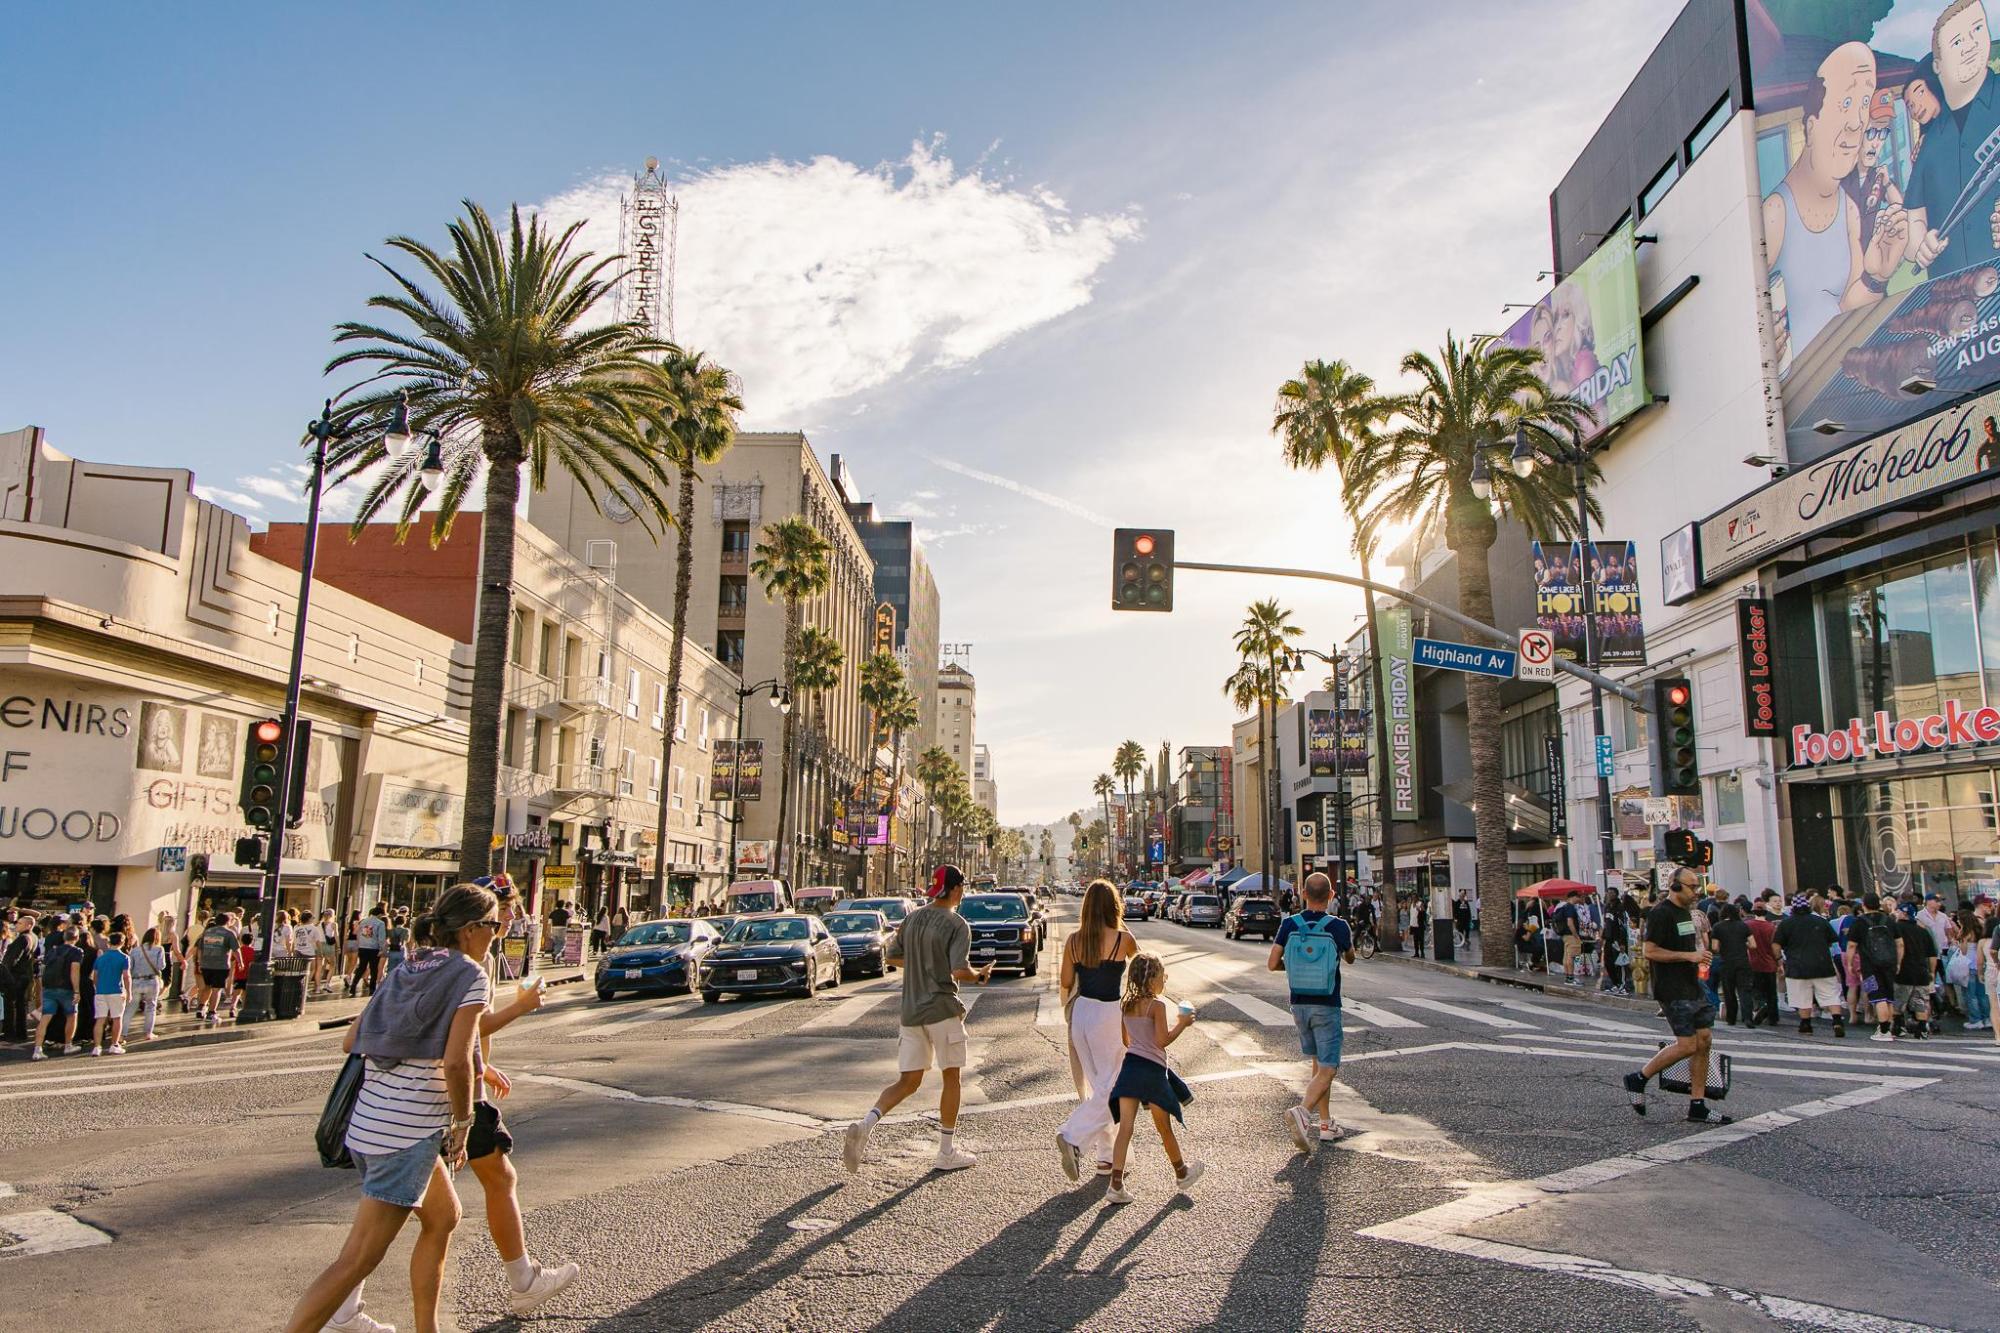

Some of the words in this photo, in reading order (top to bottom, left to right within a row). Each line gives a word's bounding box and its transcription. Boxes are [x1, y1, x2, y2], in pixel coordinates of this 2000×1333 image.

[638, 200, 656, 211] EL
[1926, 335, 1957, 359] NEW
[1961, 315, 2000, 342] SEAS
[1799, 405, 1976, 520] Michelob
[1537, 585, 1558, 594] SOME
[1595, 584, 1614, 593] SOME
[1537, 593, 1582, 614] HOT
[1595, 592, 1639, 613] HOT
[878, 613, 892, 625] EL
[1400, 619, 1408, 650] AUGUST
[1747, 605, 1768, 676] Locker
[1422, 645, 1482, 666] Highland
[1488, 655, 1505, 669] Av
[1522, 666, 1533, 675] ON
[1535, 667, 1550, 676] RED
[1339, 677, 1348, 692] PLAY
[1390, 655, 1410, 720] FRIDAY
[0, 696, 132, 738] ENIRS
[1752, 683, 1773, 729] Foot
[1310, 737, 1335, 749] HOT
[1341, 737, 1365, 749] HOT
[1792, 718, 1866, 766] Foot
[2, 751, 31, 782] F
[1394, 723, 1413, 811] FREAKIER
[1602, 738, 1613, 774] SYNC
[713, 766, 734, 776] HOT
[740, 766, 762, 776] HOT
[148, 778, 232, 814] GIFTS
[161, 848, 185, 861] ATM
